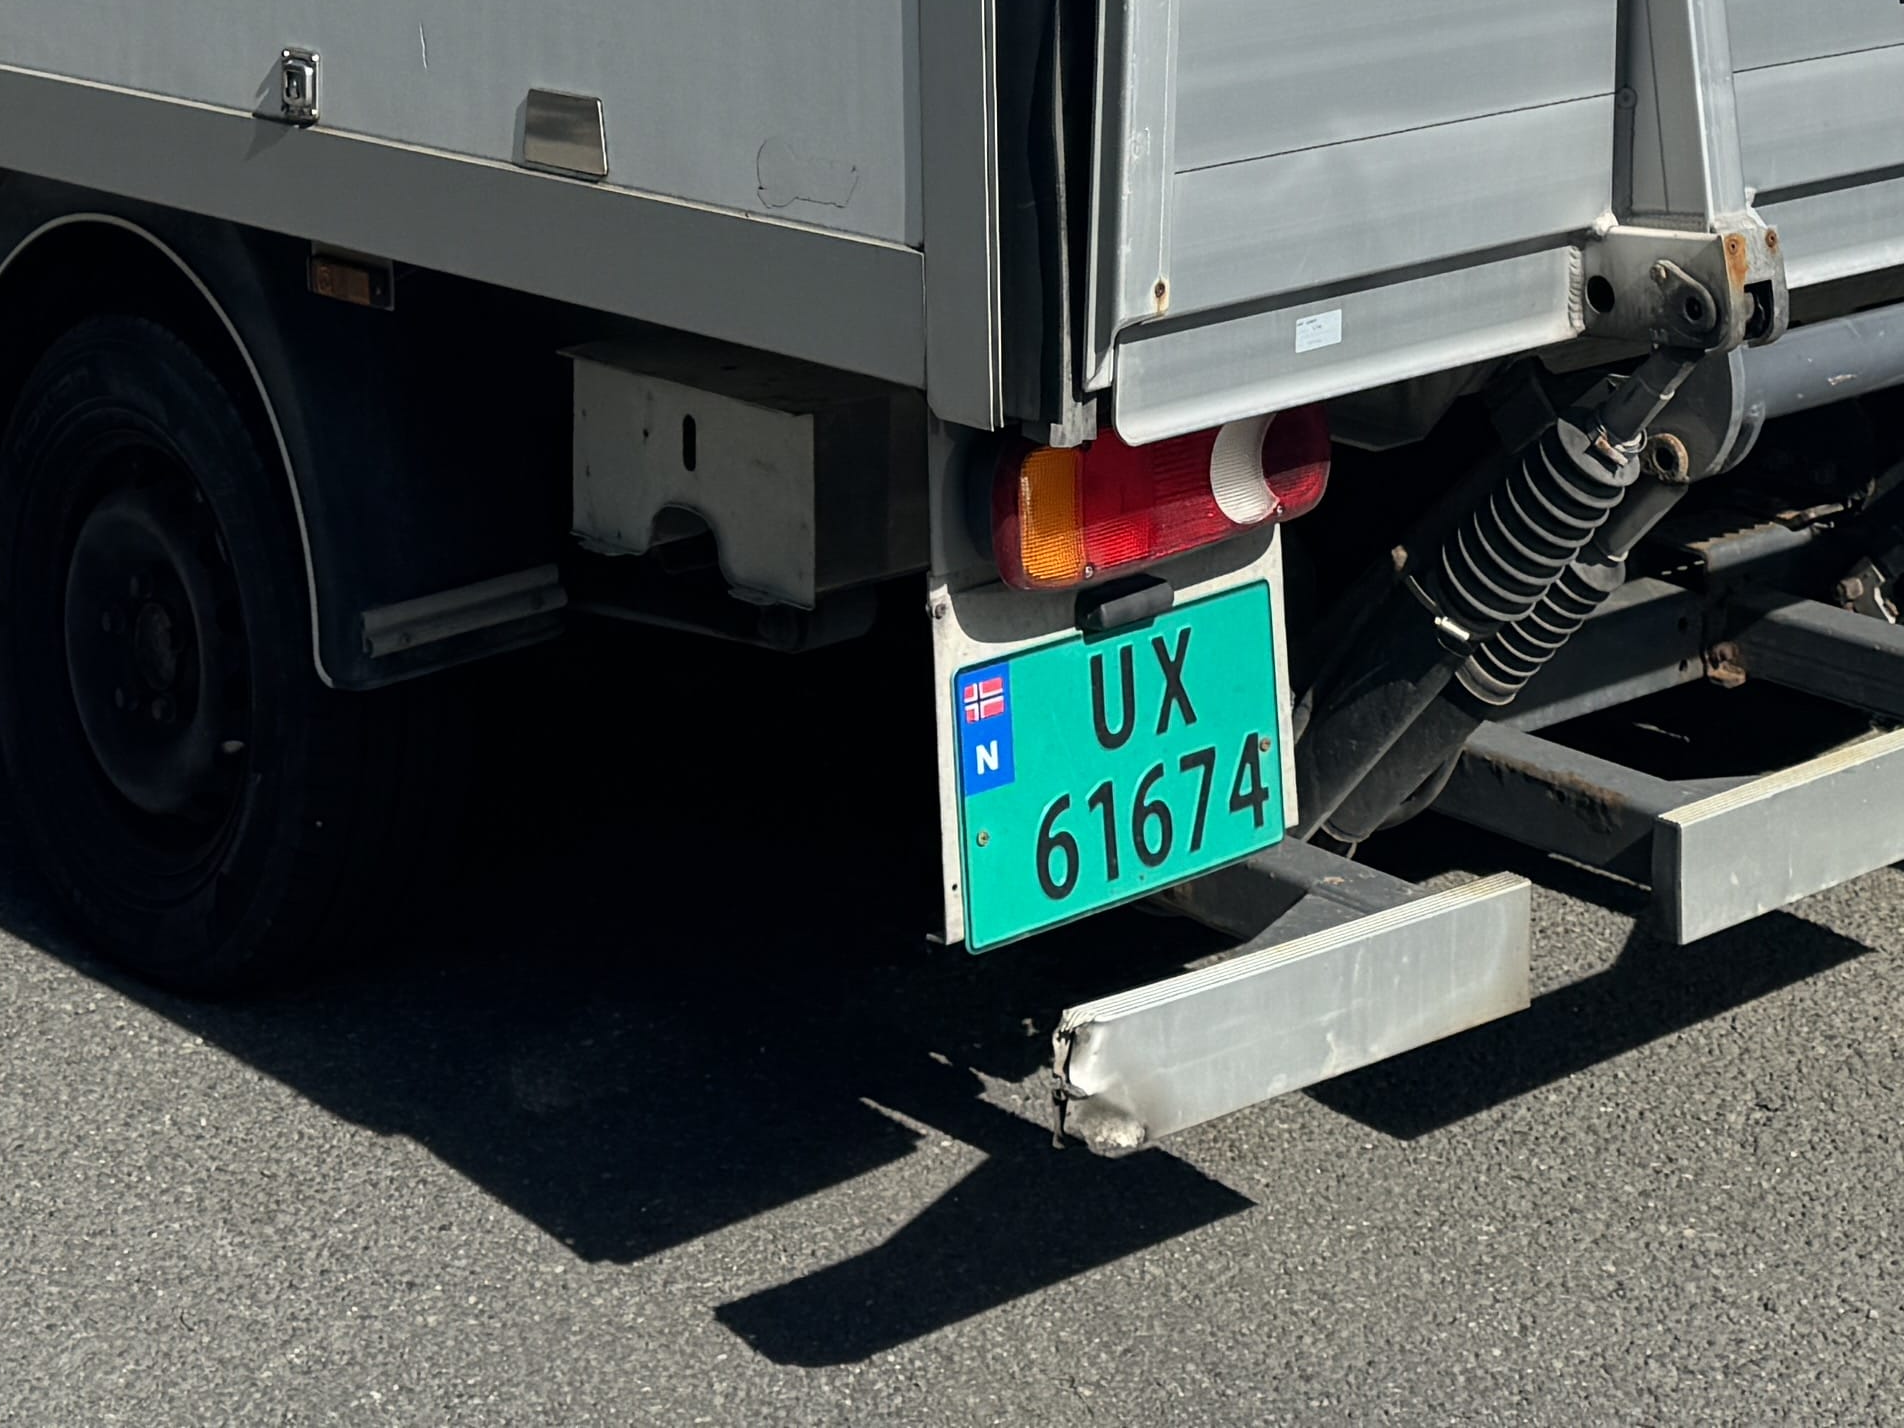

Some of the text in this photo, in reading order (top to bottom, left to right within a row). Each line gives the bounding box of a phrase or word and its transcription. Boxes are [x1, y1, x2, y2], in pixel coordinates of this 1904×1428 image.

[1089, 627, 1197, 751] UX
[975, 740, 1000, 776] N
[1035, 731, 1271, 901] 61674
